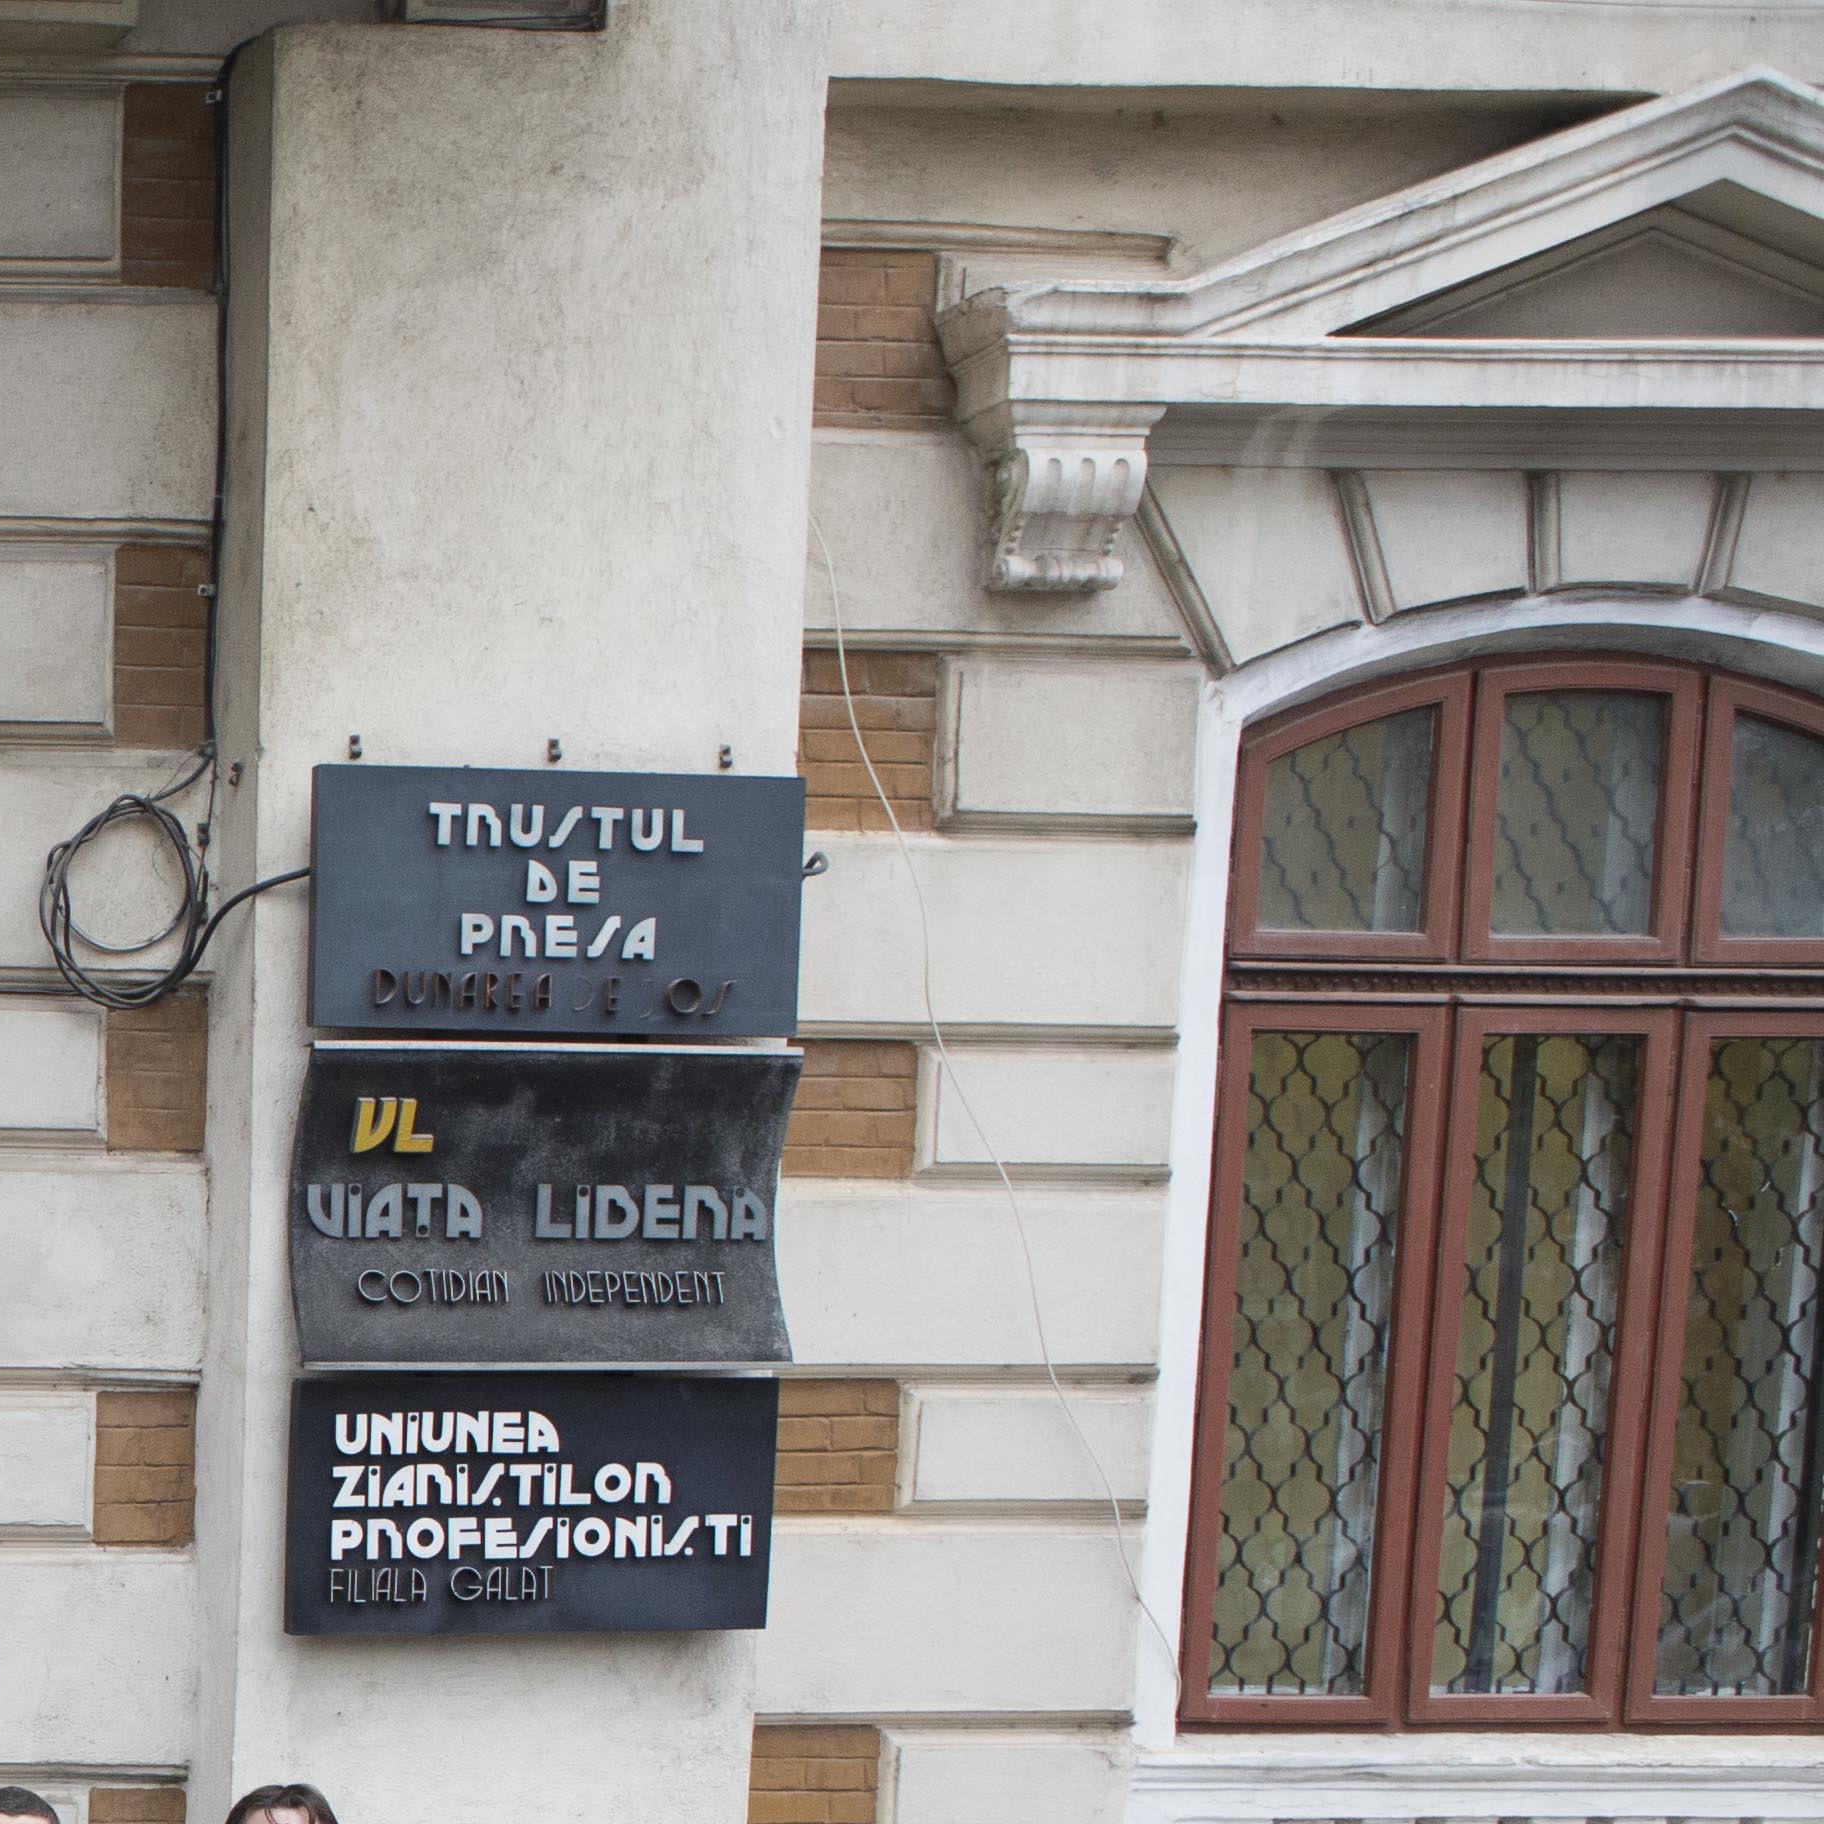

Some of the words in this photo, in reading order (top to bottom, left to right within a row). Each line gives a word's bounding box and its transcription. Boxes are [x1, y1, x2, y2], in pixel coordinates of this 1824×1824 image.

[429, 802, 704, 853] TRUSTUL
[526, 859, 600, 904] DE
[460, 912, 656, 960] PRESA
[351, 1097, 434, 1153] VL
[358, 1269, 509, 1303] COTIDIAN
[544, 1270, 726, 1304] INDEPENDENT
[335, 1410, 560, 1455] UNIUNEA
[330, 1567, 427, 1603] FILIALA
